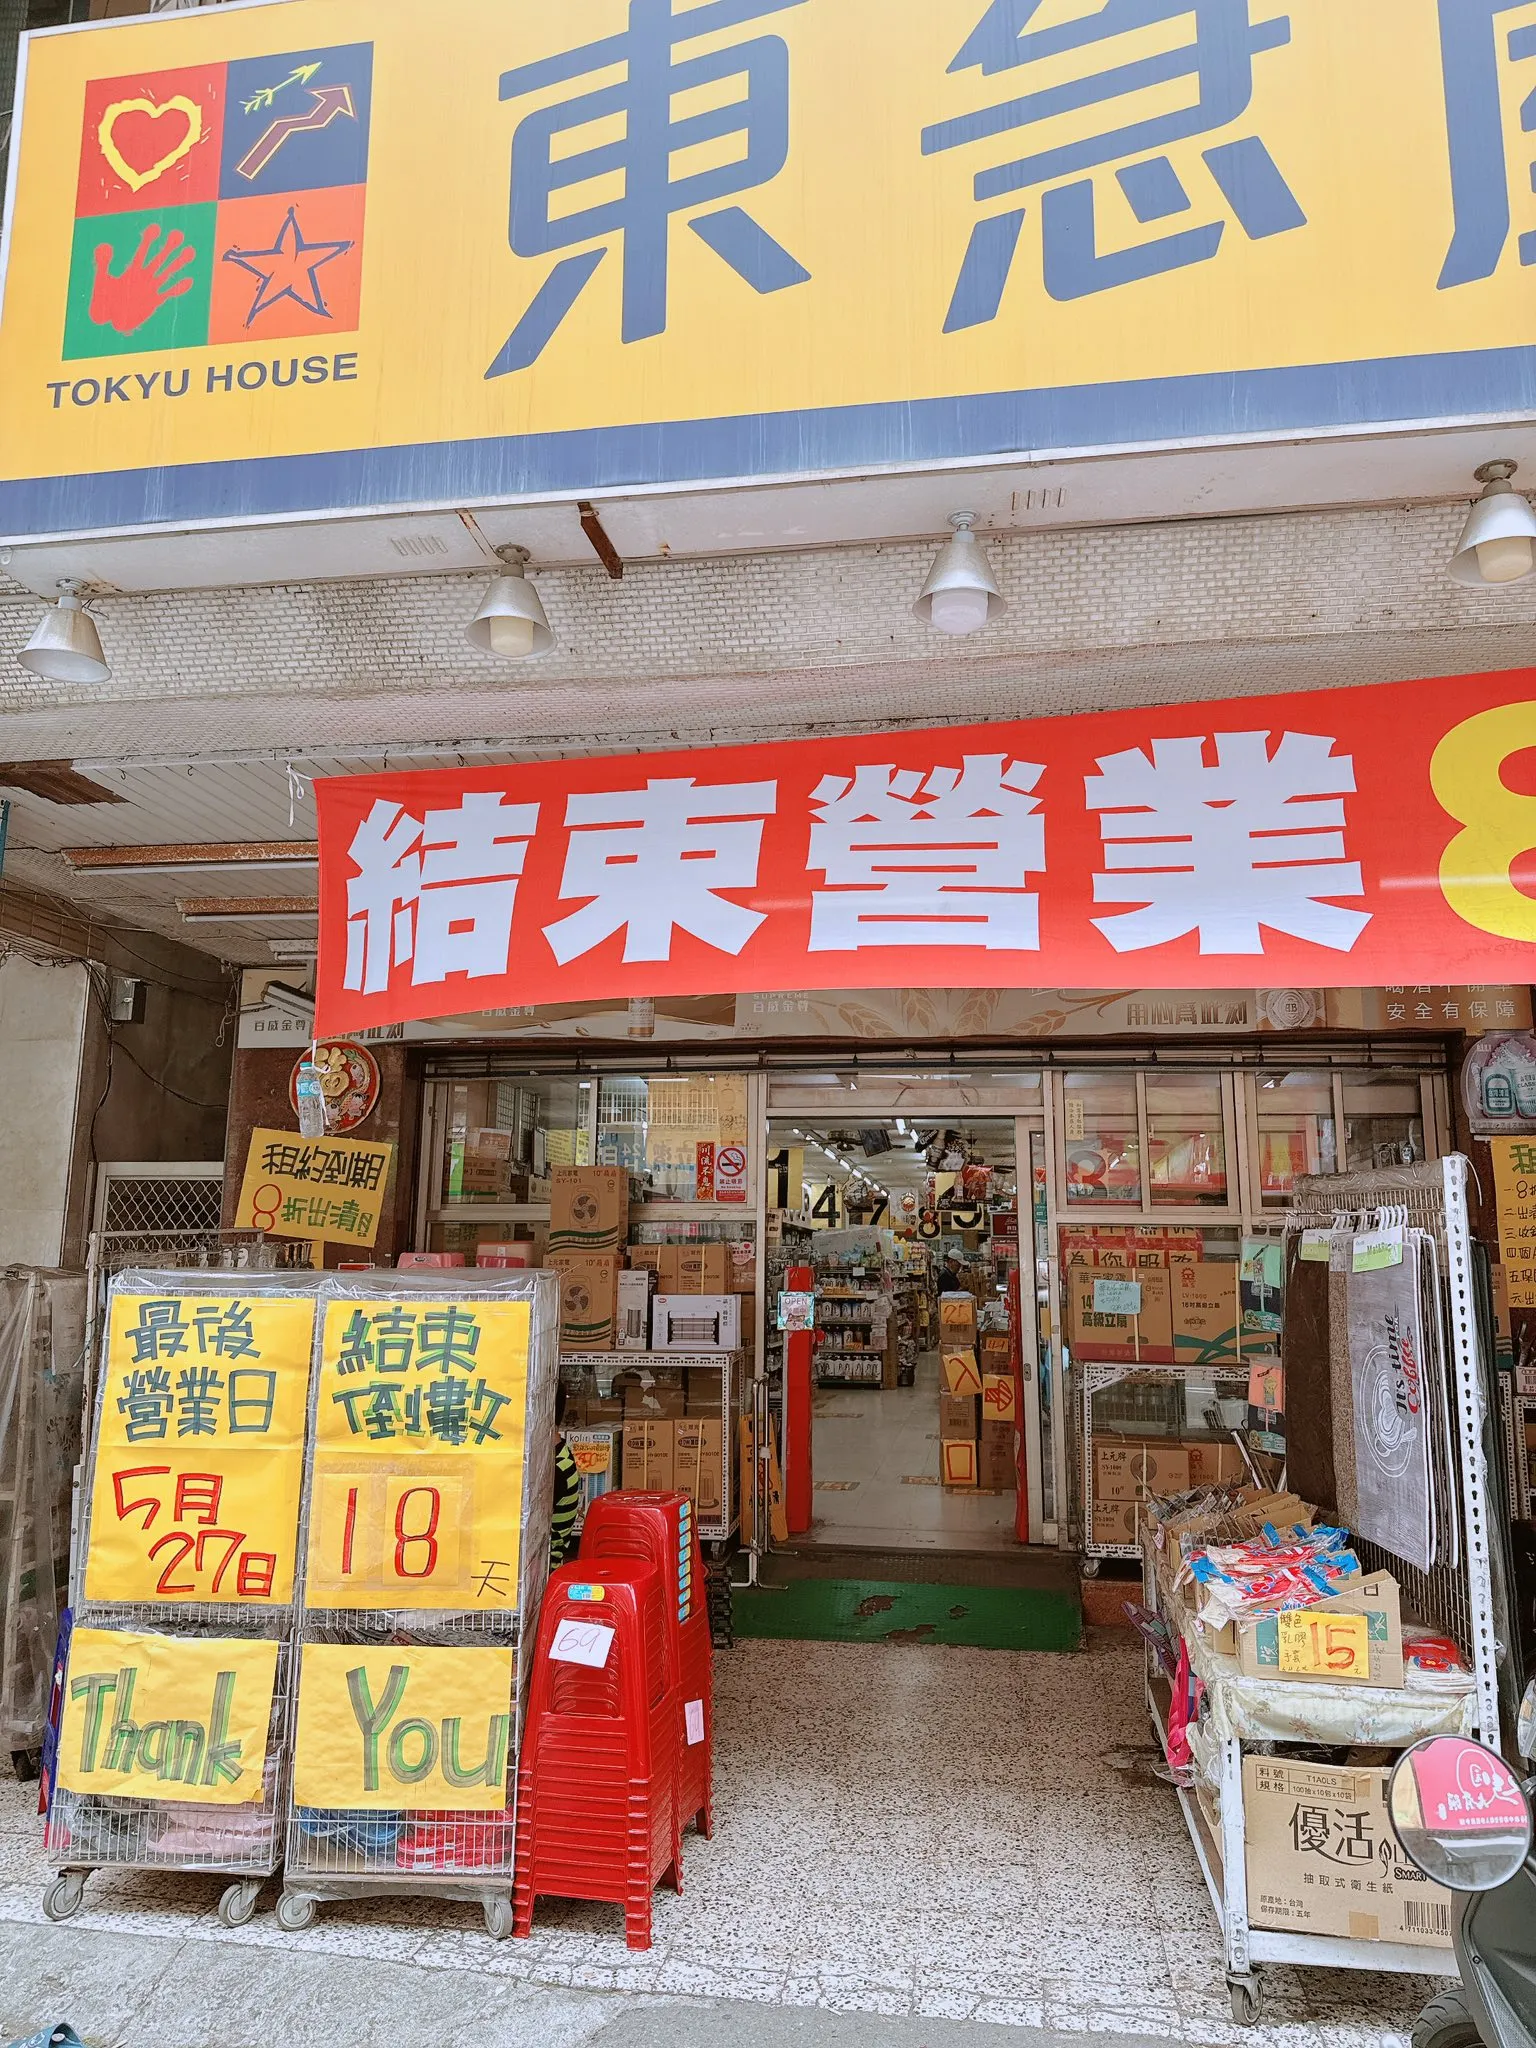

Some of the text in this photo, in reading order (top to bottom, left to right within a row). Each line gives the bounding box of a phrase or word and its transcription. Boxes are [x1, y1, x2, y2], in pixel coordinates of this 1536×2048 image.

[485, 0, 1536, 379] 東急
[47, 352, 359, 409] TOKYU HOUSE
[343, 730, 1373, 995] 結束營業
[1387, 1000, 1515, 1020] 安全有保障
[262, 1143, 386, 1191] 租約到期
[700, 1144, 712, 1187] 川流不息
[124, 1300, 262, 1364] 最後
[784, 1297, 808, 1305] OPEN
[336, 1305, 481, 1376] 結束
[116, 1366, 277, 1443] 營業日
[332, 1375, 511, 1446] 倒數
[112, 1465, 224, 1530] 5月
[148, 1529, 277, 1597] 27日
[340, 1486, 511, 1598] 18 天
[557, 1628, 601, 1653] 69
[1310, 1621, 1356, 1670] 15
[71, 1666, 244, 1787] Thank
[346, 1664, 511, 1792] You
[1259, 1767, 1285, 1780] 料號
[1259, 1780, 1285, 1793] 規格
[1289, 1802, 1374, 1862] 優活
[1303, 1872, 1394, 1895] 抽取式衛生紙
